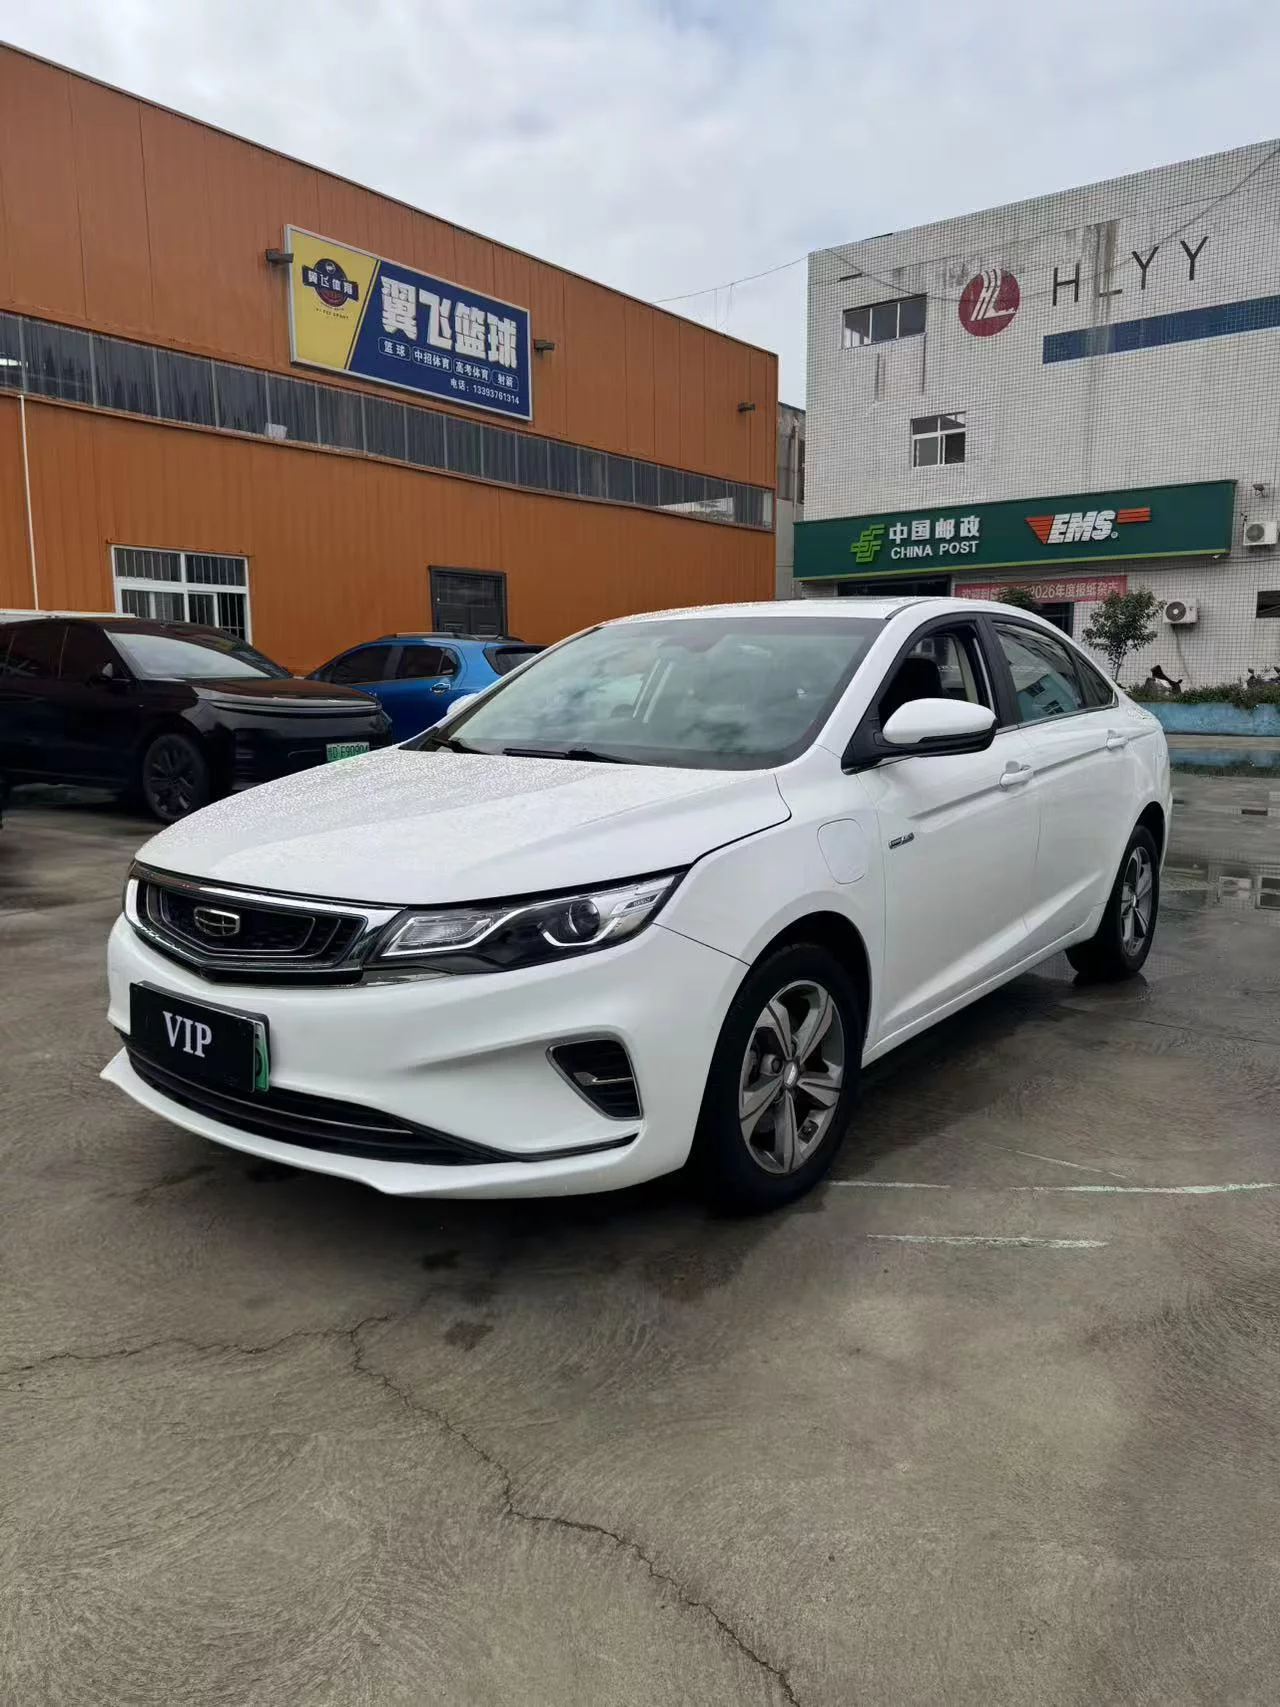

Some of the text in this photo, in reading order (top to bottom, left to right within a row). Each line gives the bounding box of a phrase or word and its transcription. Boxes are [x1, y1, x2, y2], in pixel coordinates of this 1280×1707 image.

[381, 275, 517, 370] 翼飞篮球
[384, 340, 406, 357] 篮球
[414, 350, 450, 370] 中招体育
[455, 361, 489, 381] 高考体育
[889, 515, 980, 544] 中国邮政
[1047, 510, 1116, 543] EMS
[891, 540, 979, 559] CHINA POST
[162, 1010, 213, 1058] VIP
